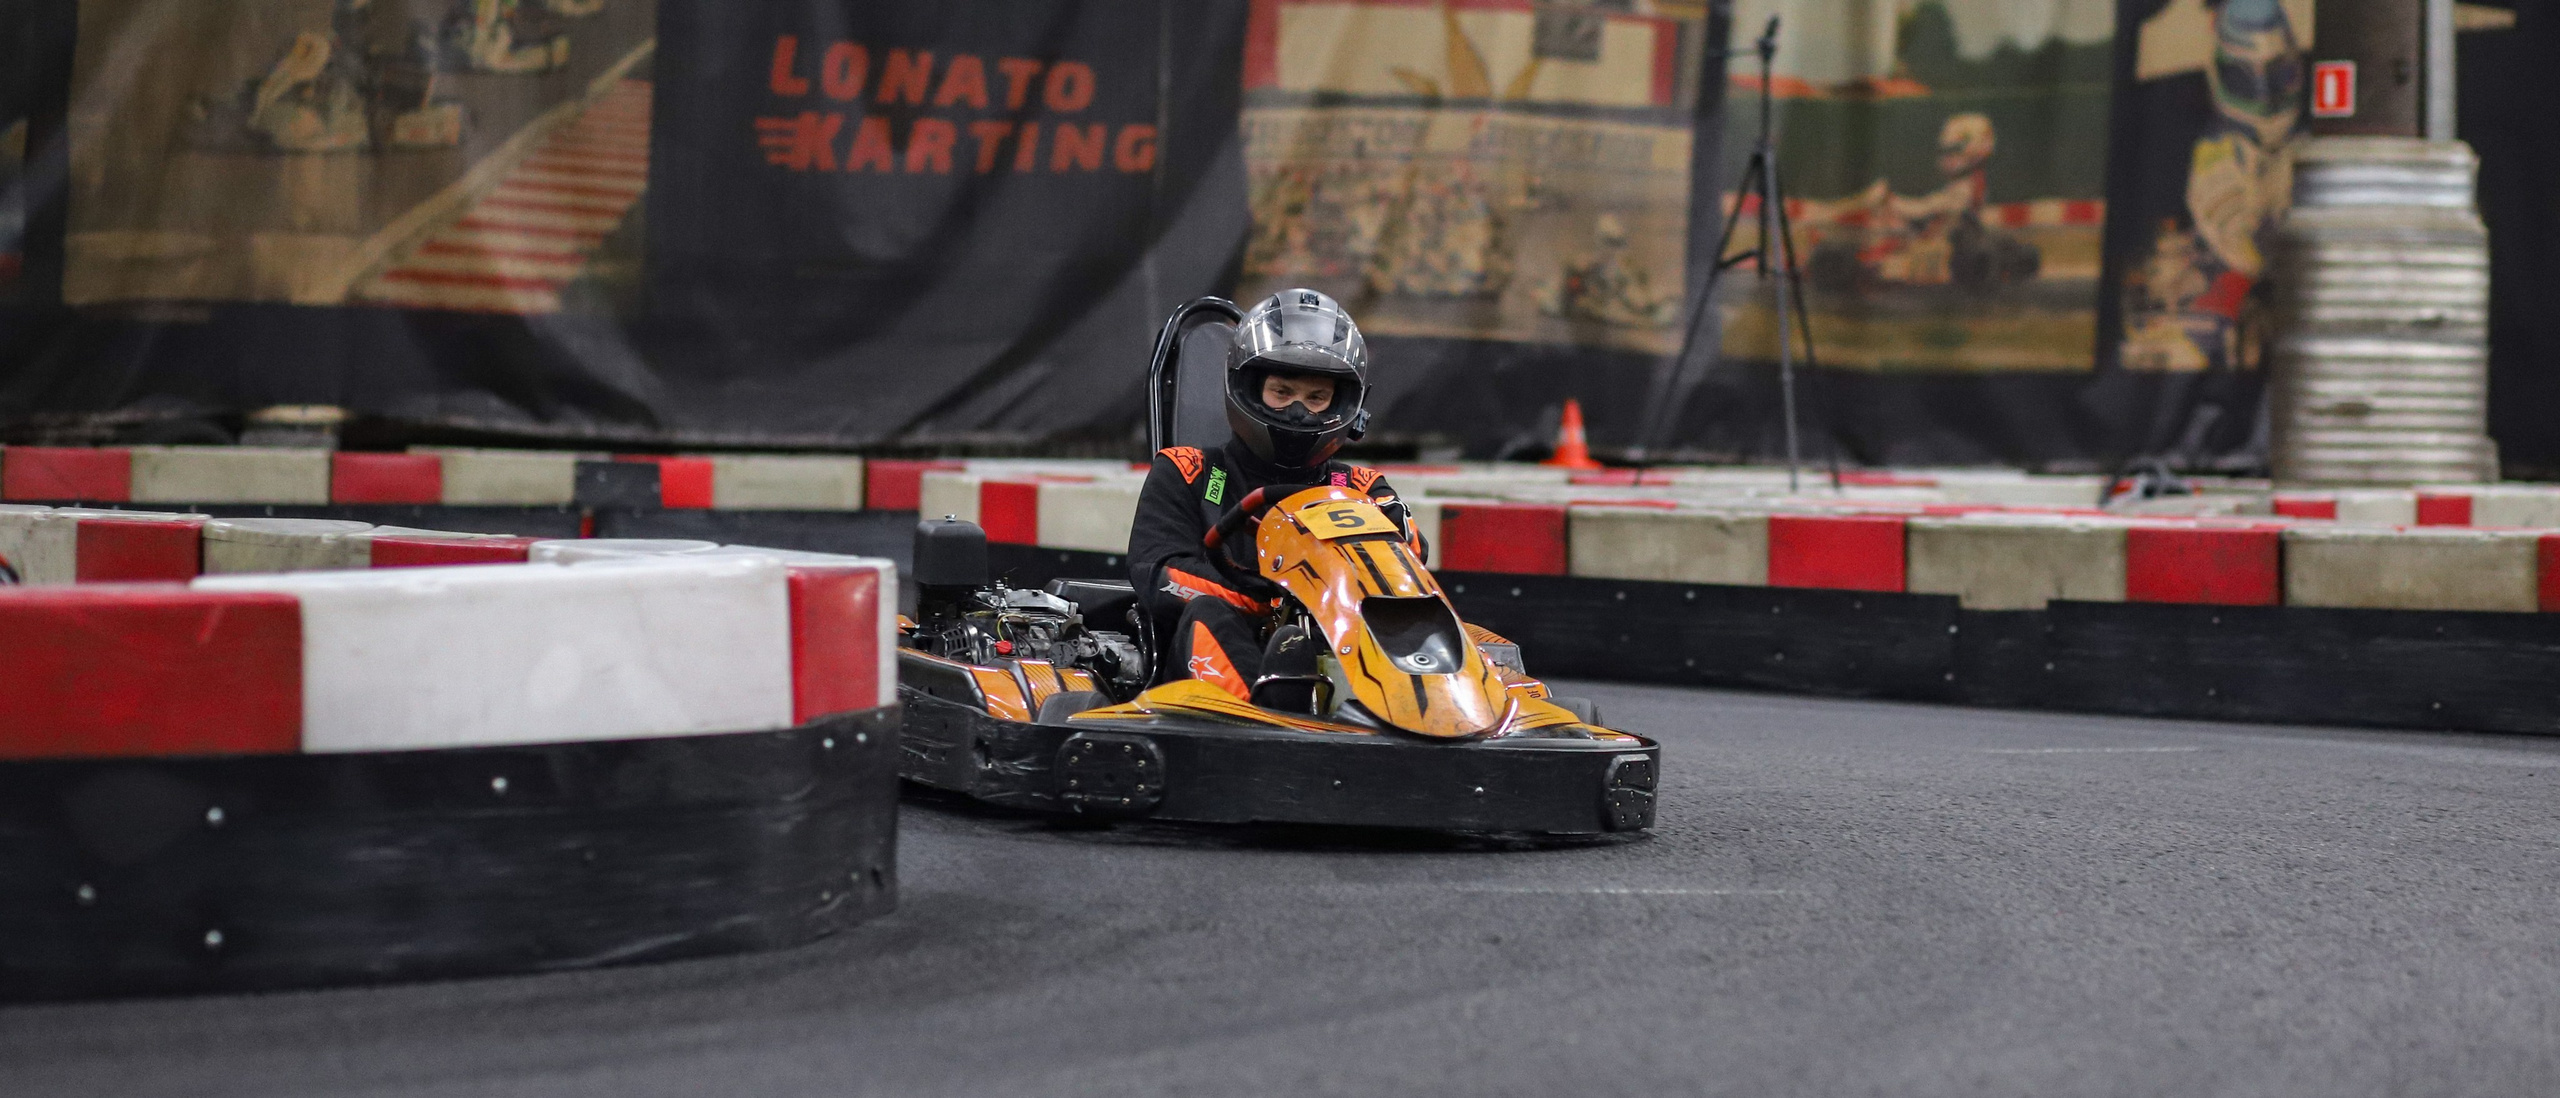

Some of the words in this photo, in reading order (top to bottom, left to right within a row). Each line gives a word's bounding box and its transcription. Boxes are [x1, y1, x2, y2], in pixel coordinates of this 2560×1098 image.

[770, 36, 1095, 111] LONATO
[757, 112, 1157, 173] KARTING
[1327, 509, 1365, 528] 5
